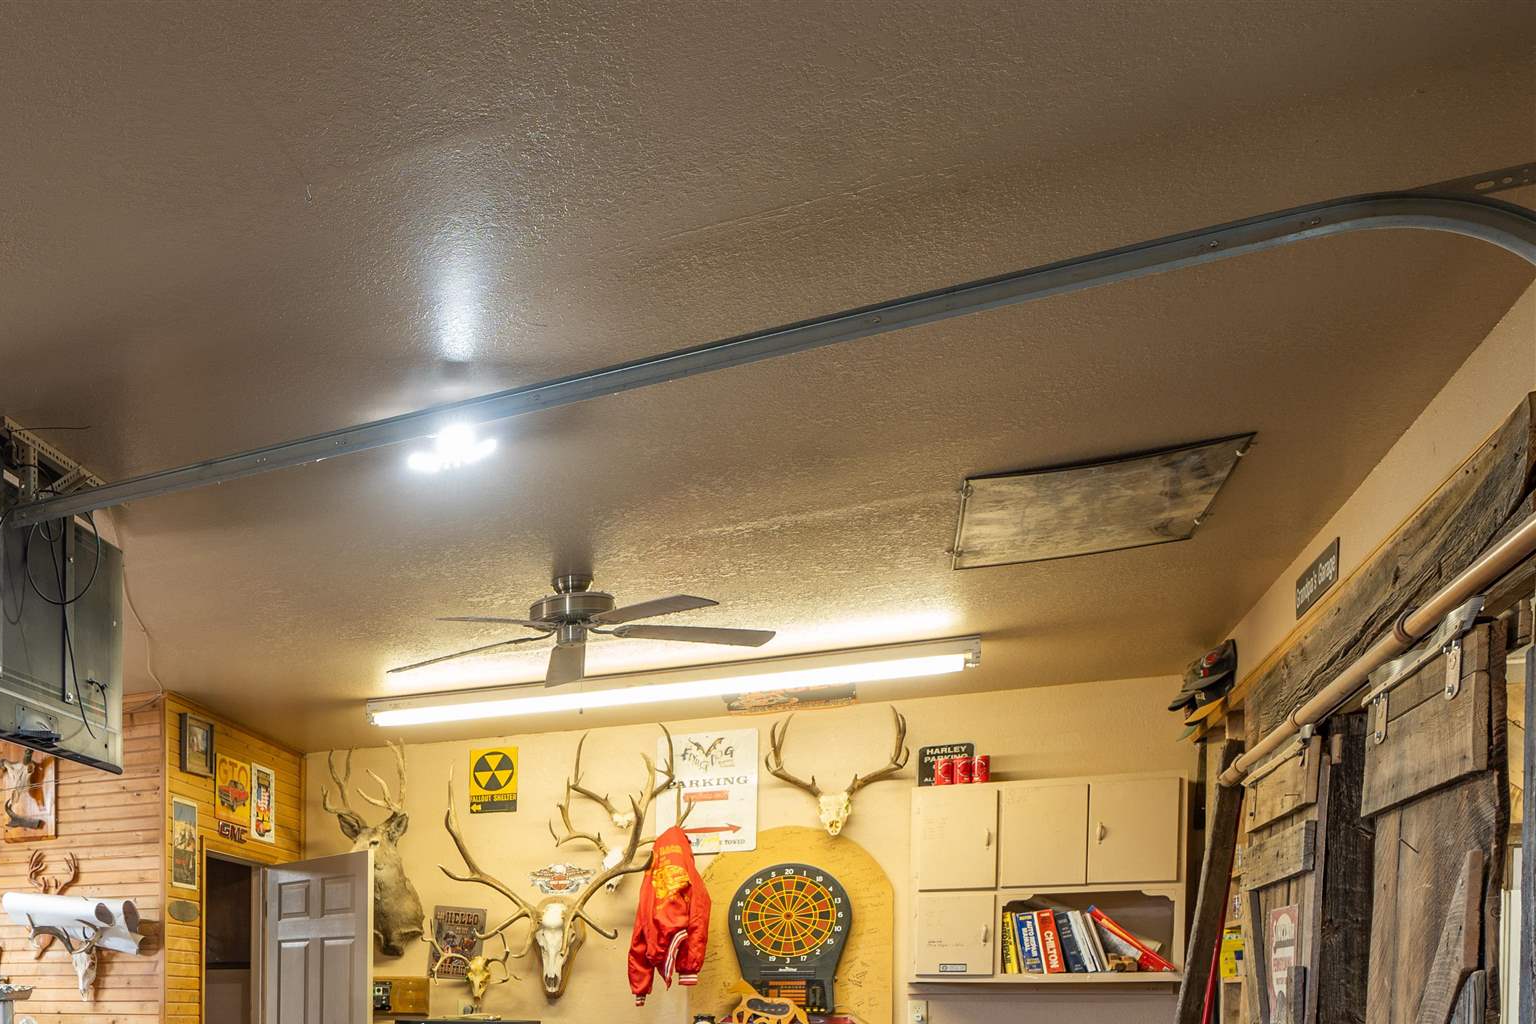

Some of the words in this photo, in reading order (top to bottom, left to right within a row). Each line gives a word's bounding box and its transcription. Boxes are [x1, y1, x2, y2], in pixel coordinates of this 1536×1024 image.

[1296, 571, 1318, 609] Grandpa's
[1318, 554, 1336, 585] Garage
[926, 745, 967, 755] HARLEY
[217, 757, 249, 787] GTO
[218, 821, 248, 844] GMC
[446, 911, 479, 926] HELLO
[1026, 921, 1034, 936] AUTO
[1021, 927, 1031, 952] MANUAL
[1029, 935, 1038, 957] REPAIR
[1044, 930, 1059, 968] CHILTON
